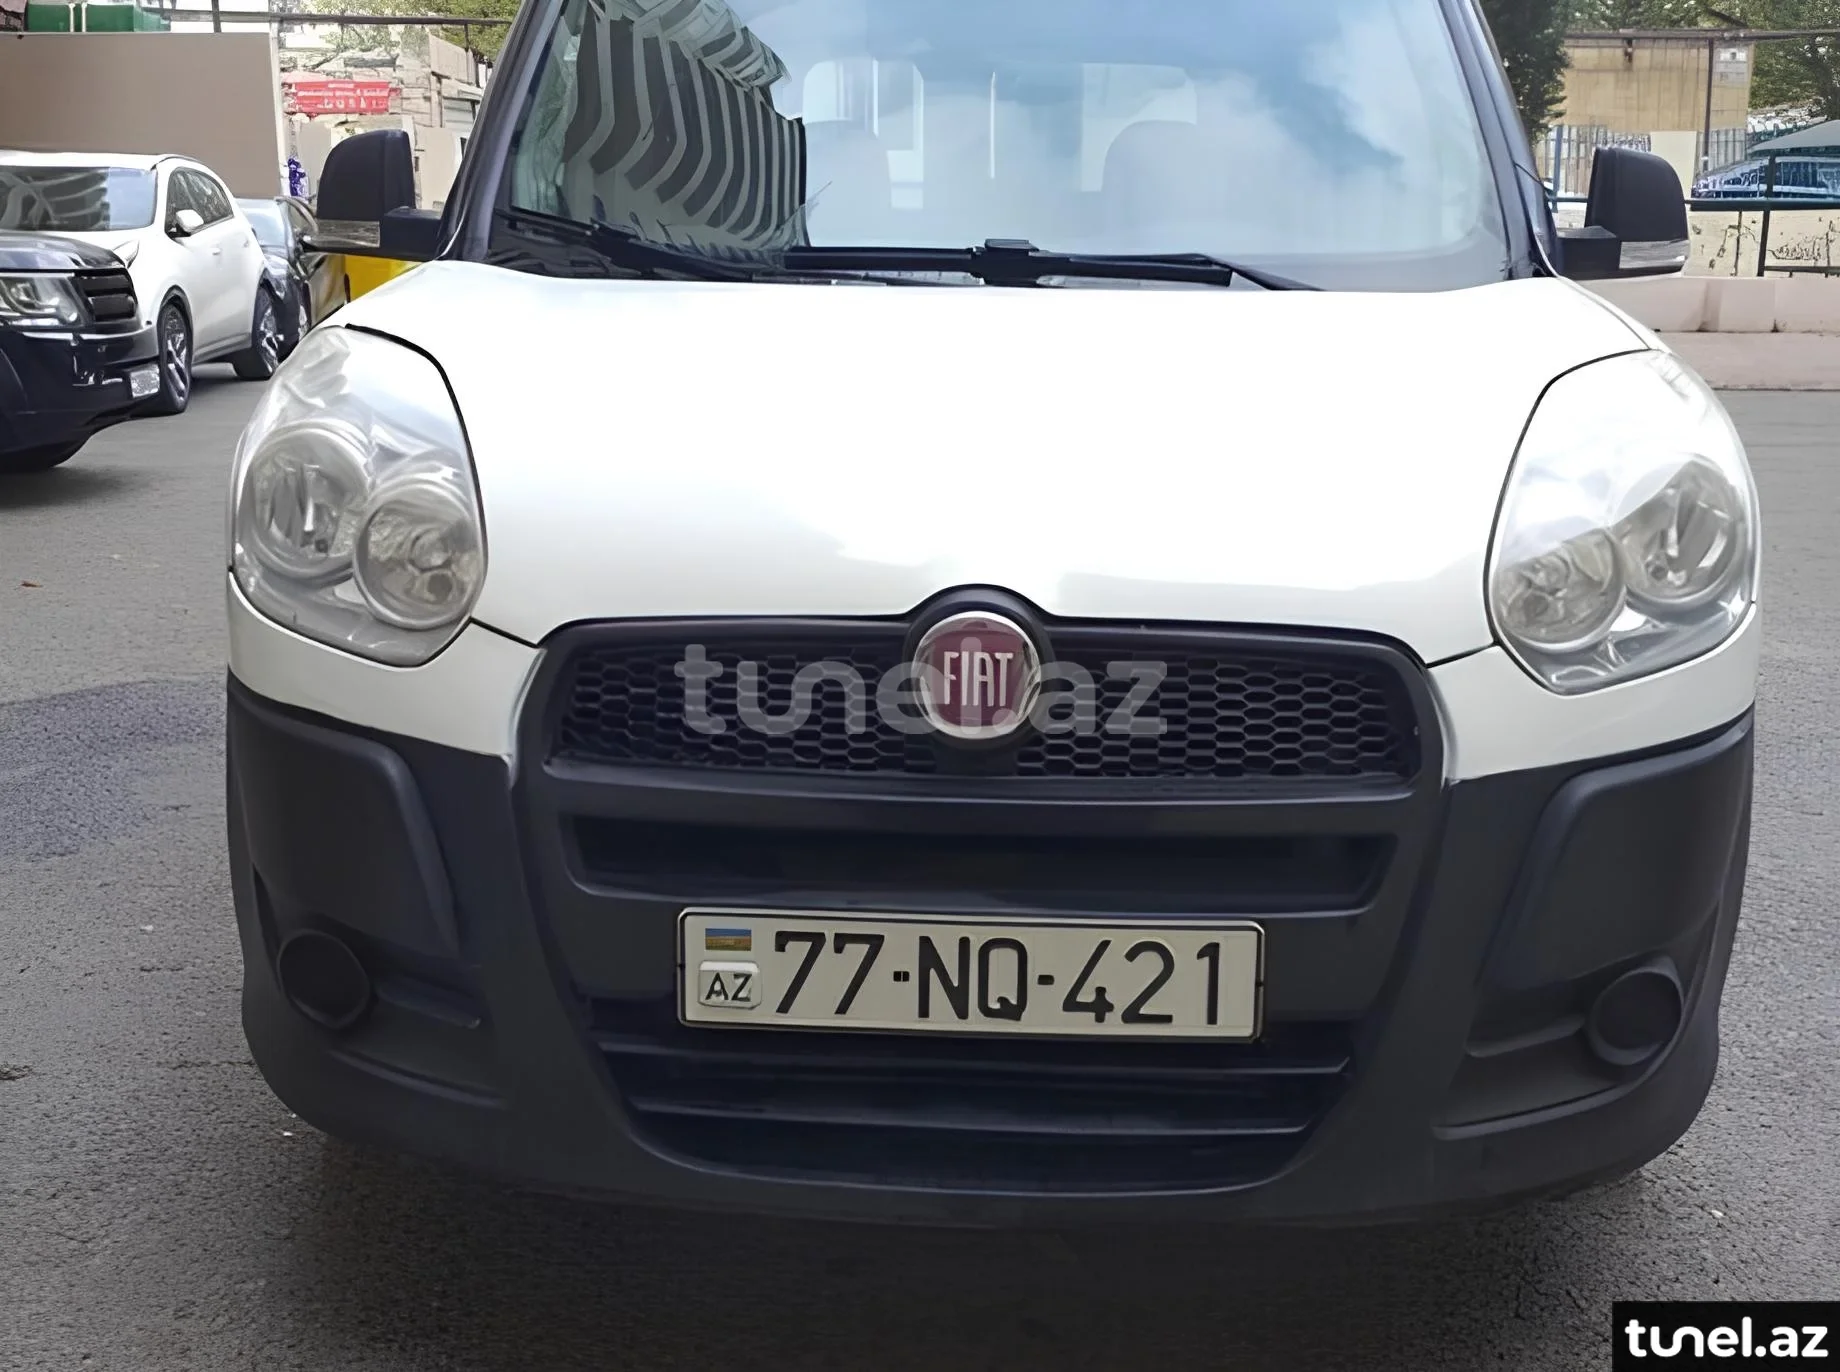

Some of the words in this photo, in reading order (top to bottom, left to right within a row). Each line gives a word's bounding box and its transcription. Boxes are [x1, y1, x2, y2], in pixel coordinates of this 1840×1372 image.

[943, 650, 1015, 707] FIAT
[705, 972, 753, 1002] AZ
[774, 930, 1221, 1026] 77-NQ-421
